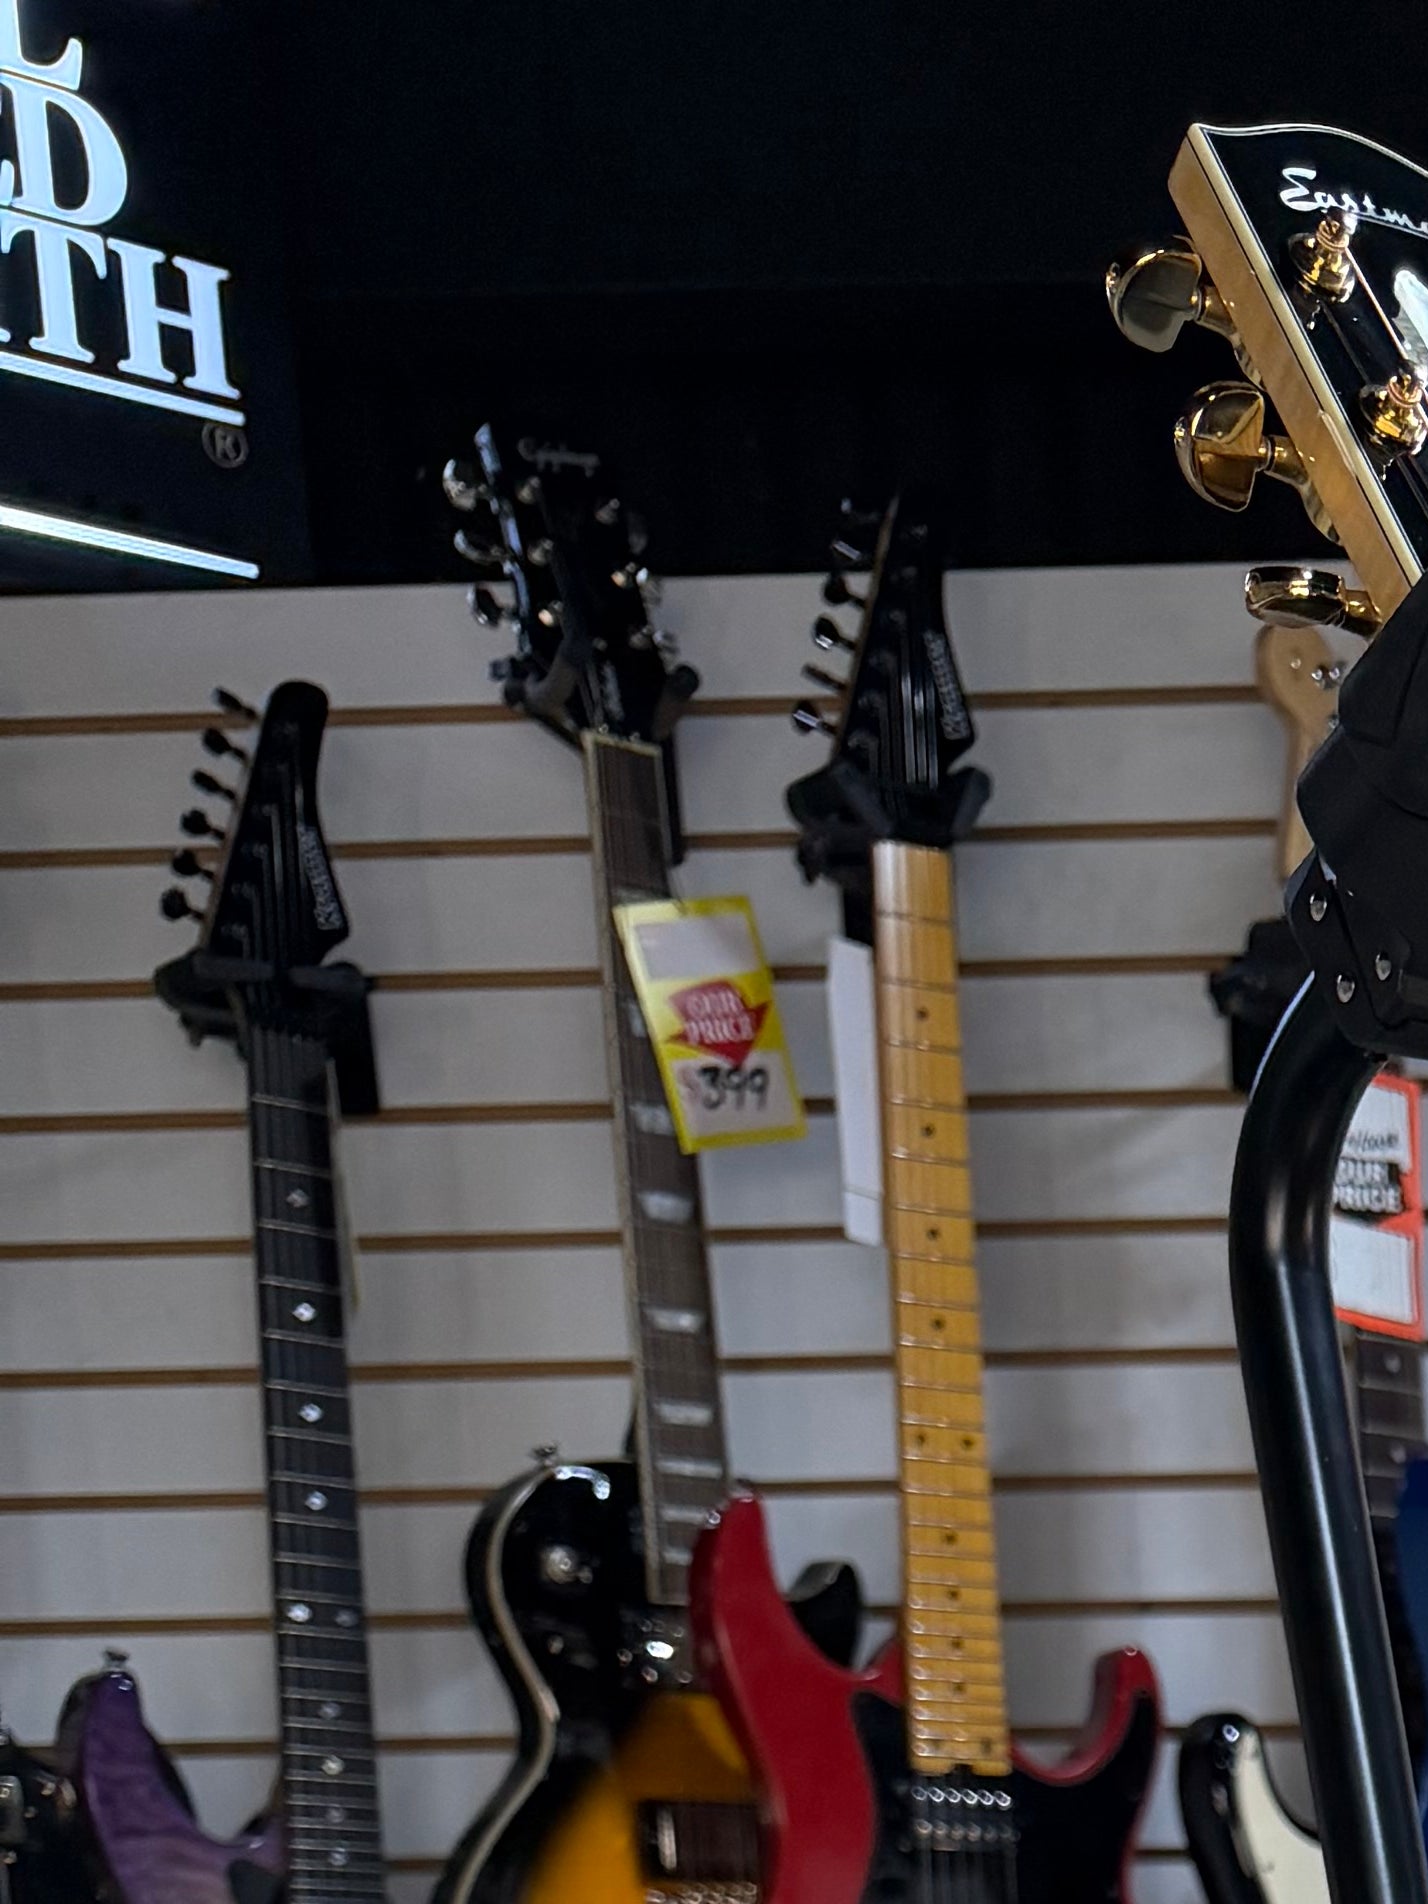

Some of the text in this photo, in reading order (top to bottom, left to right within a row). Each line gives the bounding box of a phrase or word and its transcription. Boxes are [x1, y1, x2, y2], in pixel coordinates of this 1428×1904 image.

[0, 208, 241, 400] TH
[684, 988, 742, 1022] OUR
[683, 1013, 756, 1047] PRICE
